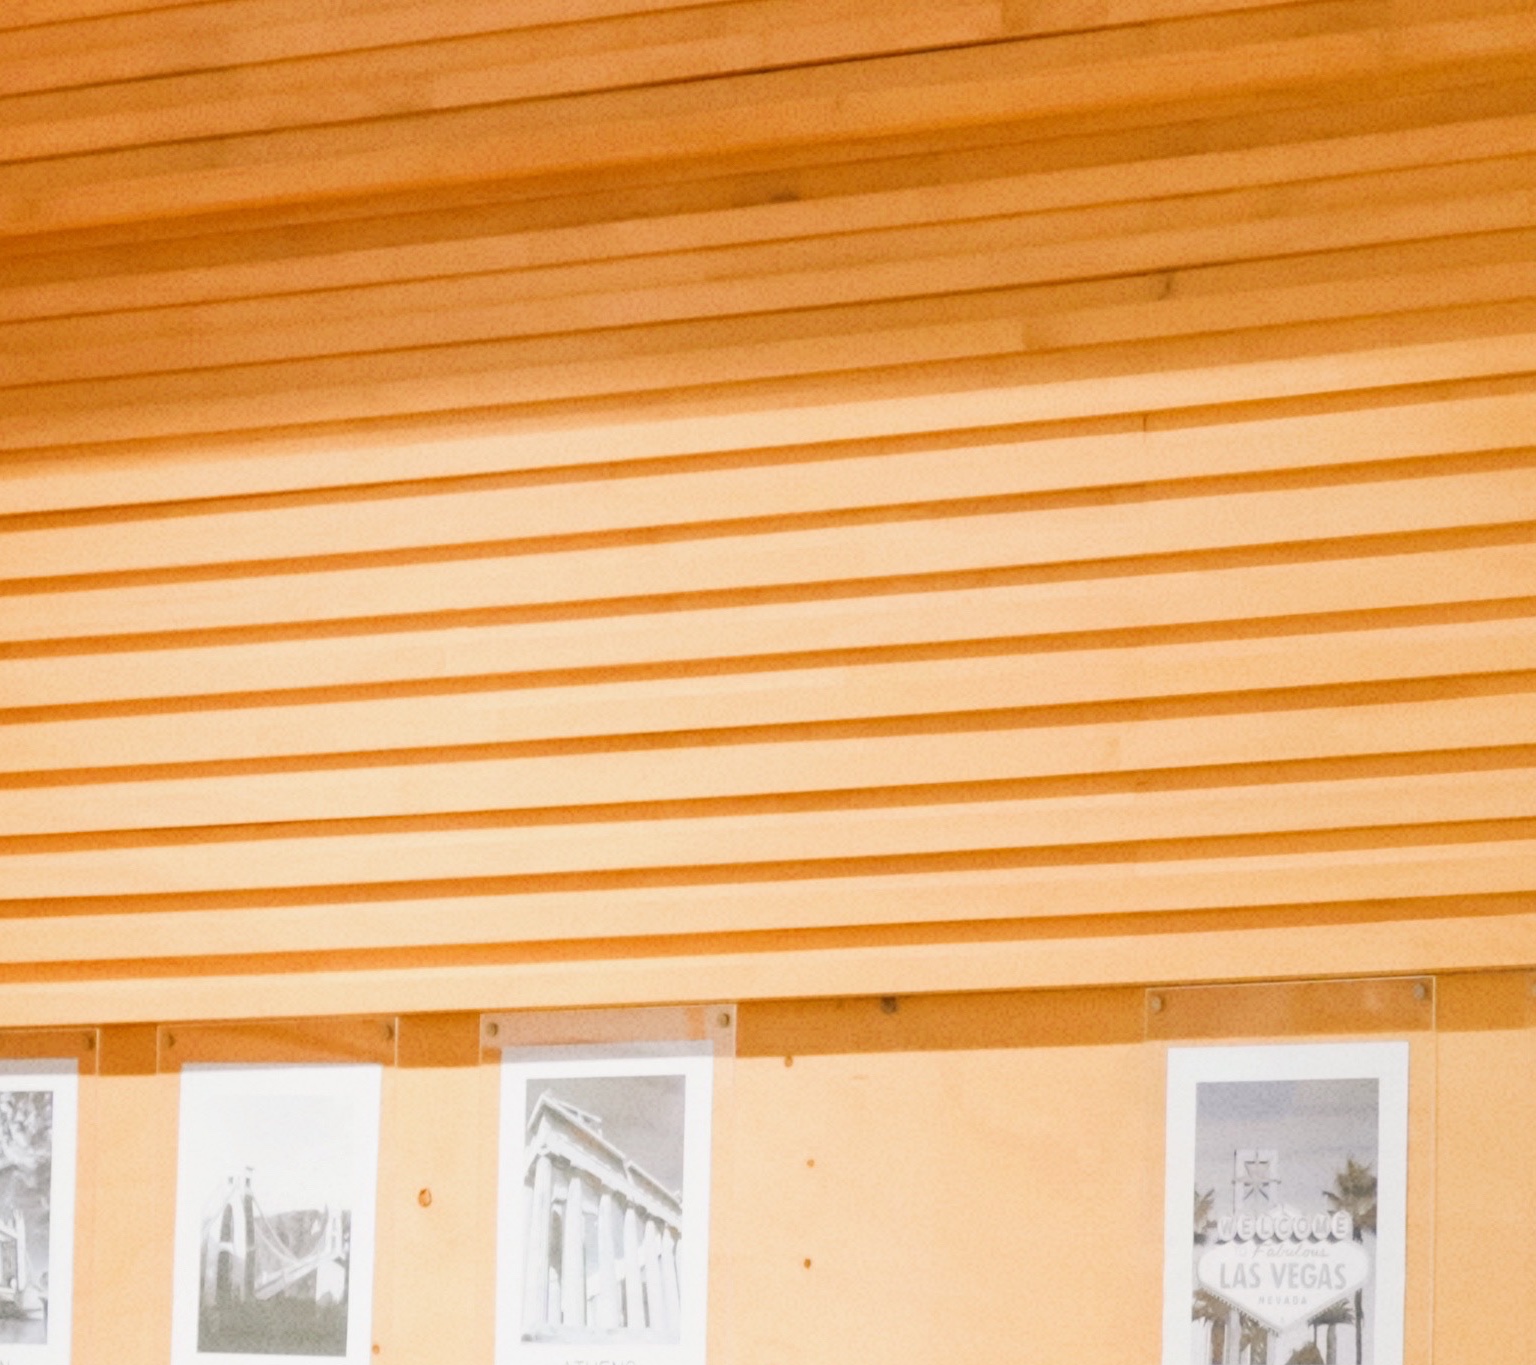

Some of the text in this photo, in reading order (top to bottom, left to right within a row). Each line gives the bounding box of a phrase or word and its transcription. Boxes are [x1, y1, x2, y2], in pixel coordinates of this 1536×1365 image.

[1219, 1214, 1347, 1236] WELCOME
[1219, 1262, 1348, 1290] LAS VEGAS
[1258, 1296, 1308, 1306] NEVADA
